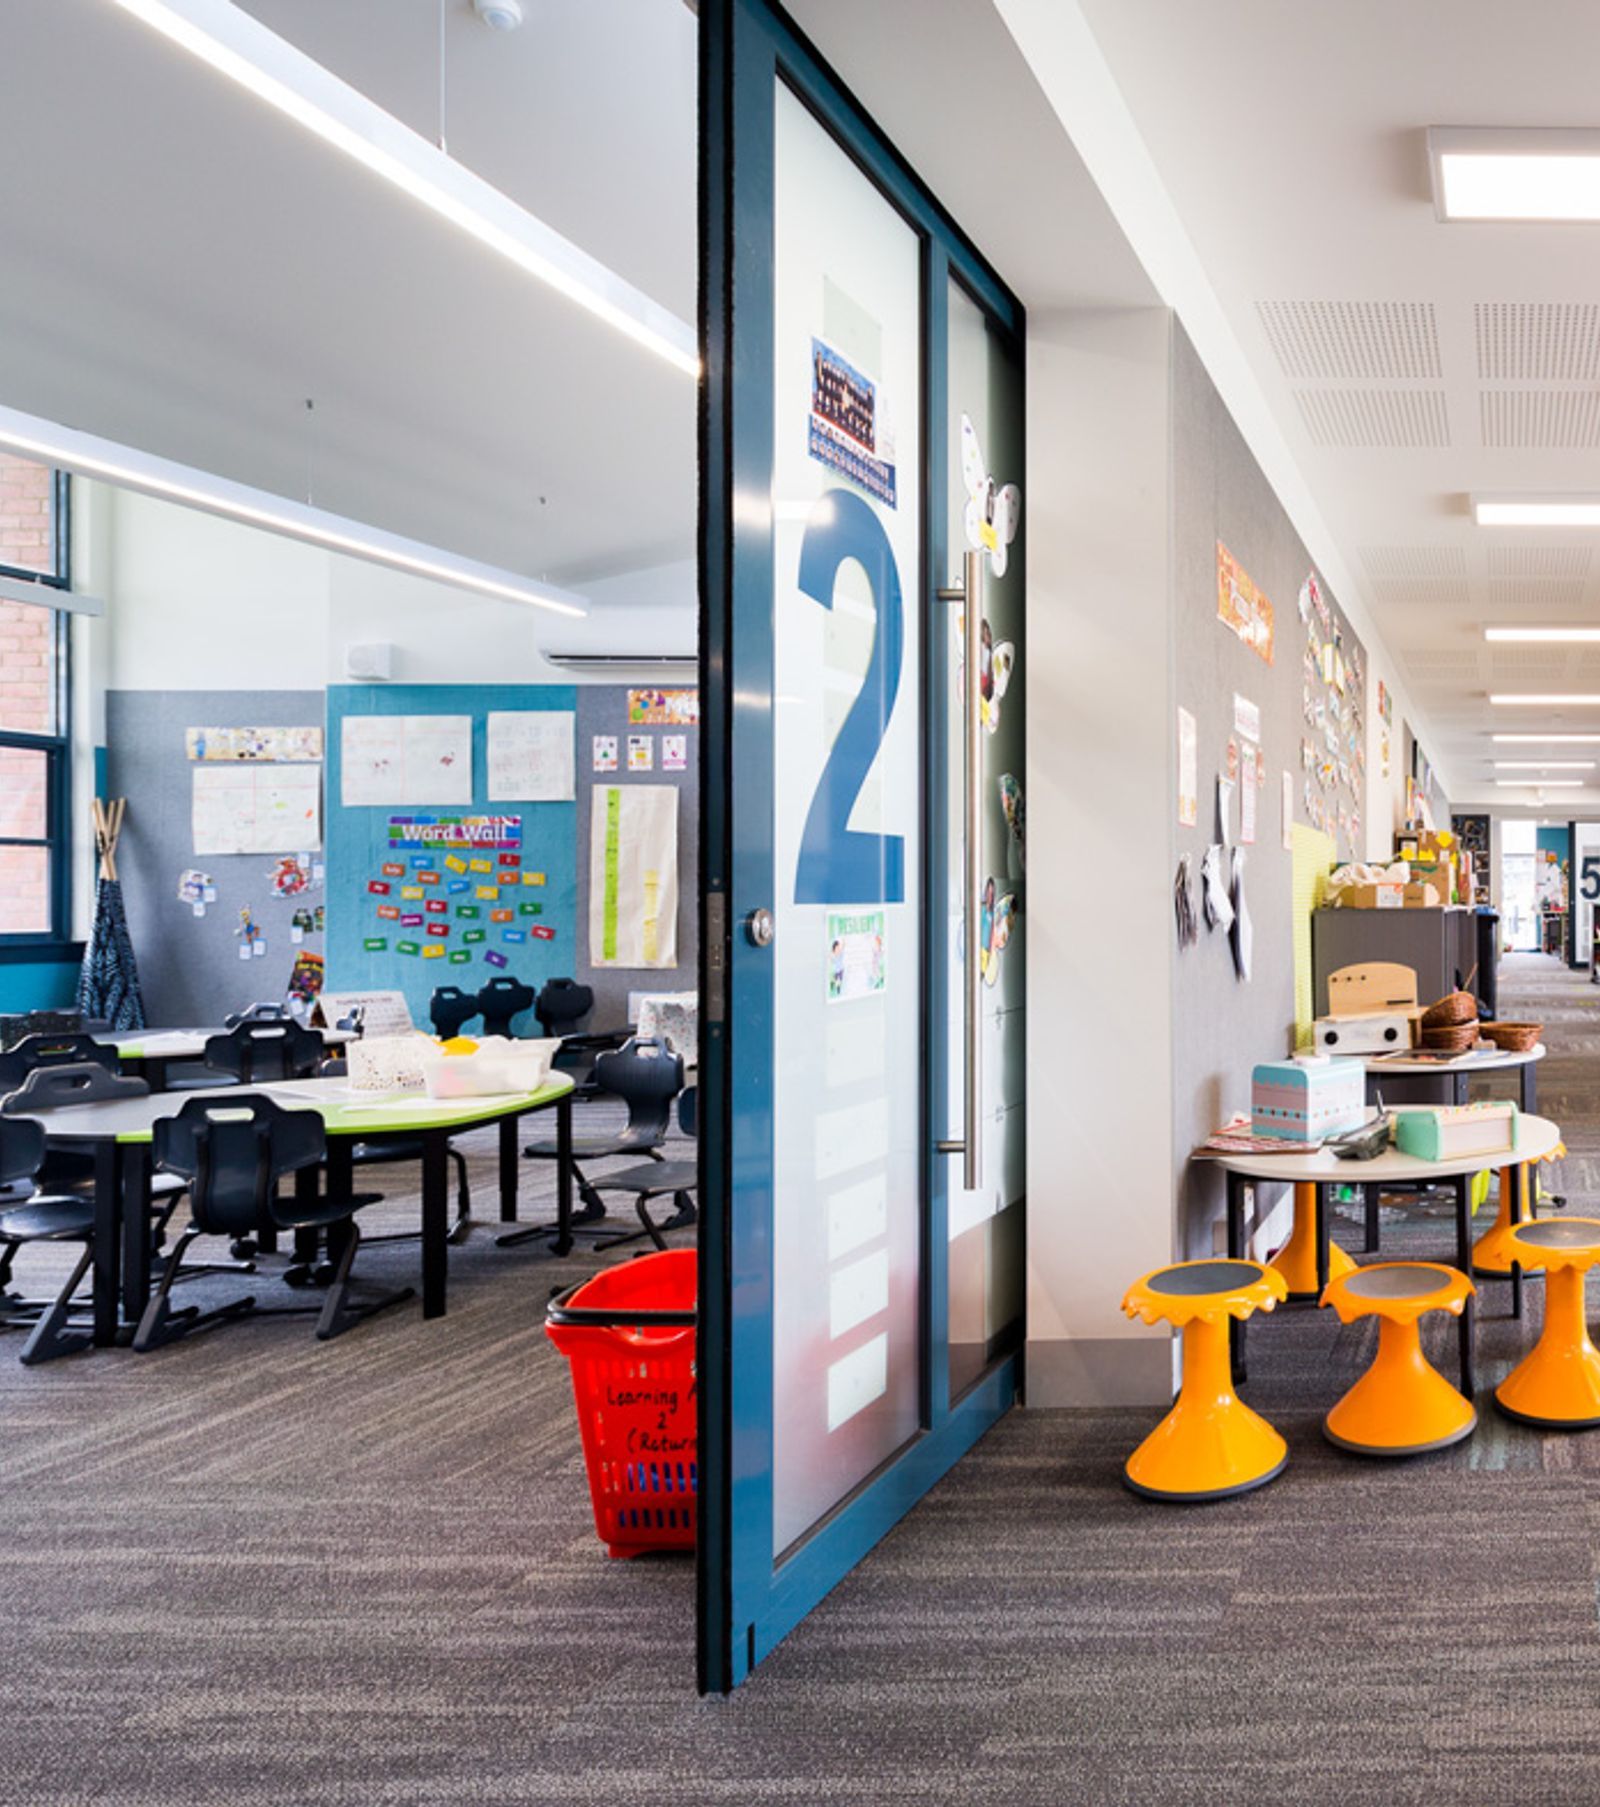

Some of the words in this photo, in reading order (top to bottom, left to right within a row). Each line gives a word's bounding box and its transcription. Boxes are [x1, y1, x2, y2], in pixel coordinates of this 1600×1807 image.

[793, 487, 905, 905] 2
[401, 823, 455, 841] Word
[461, 823, 507, 840] Wall
[607, 1388, 677, 1413] Learning
[657, 1412, 668, 1430] 2
